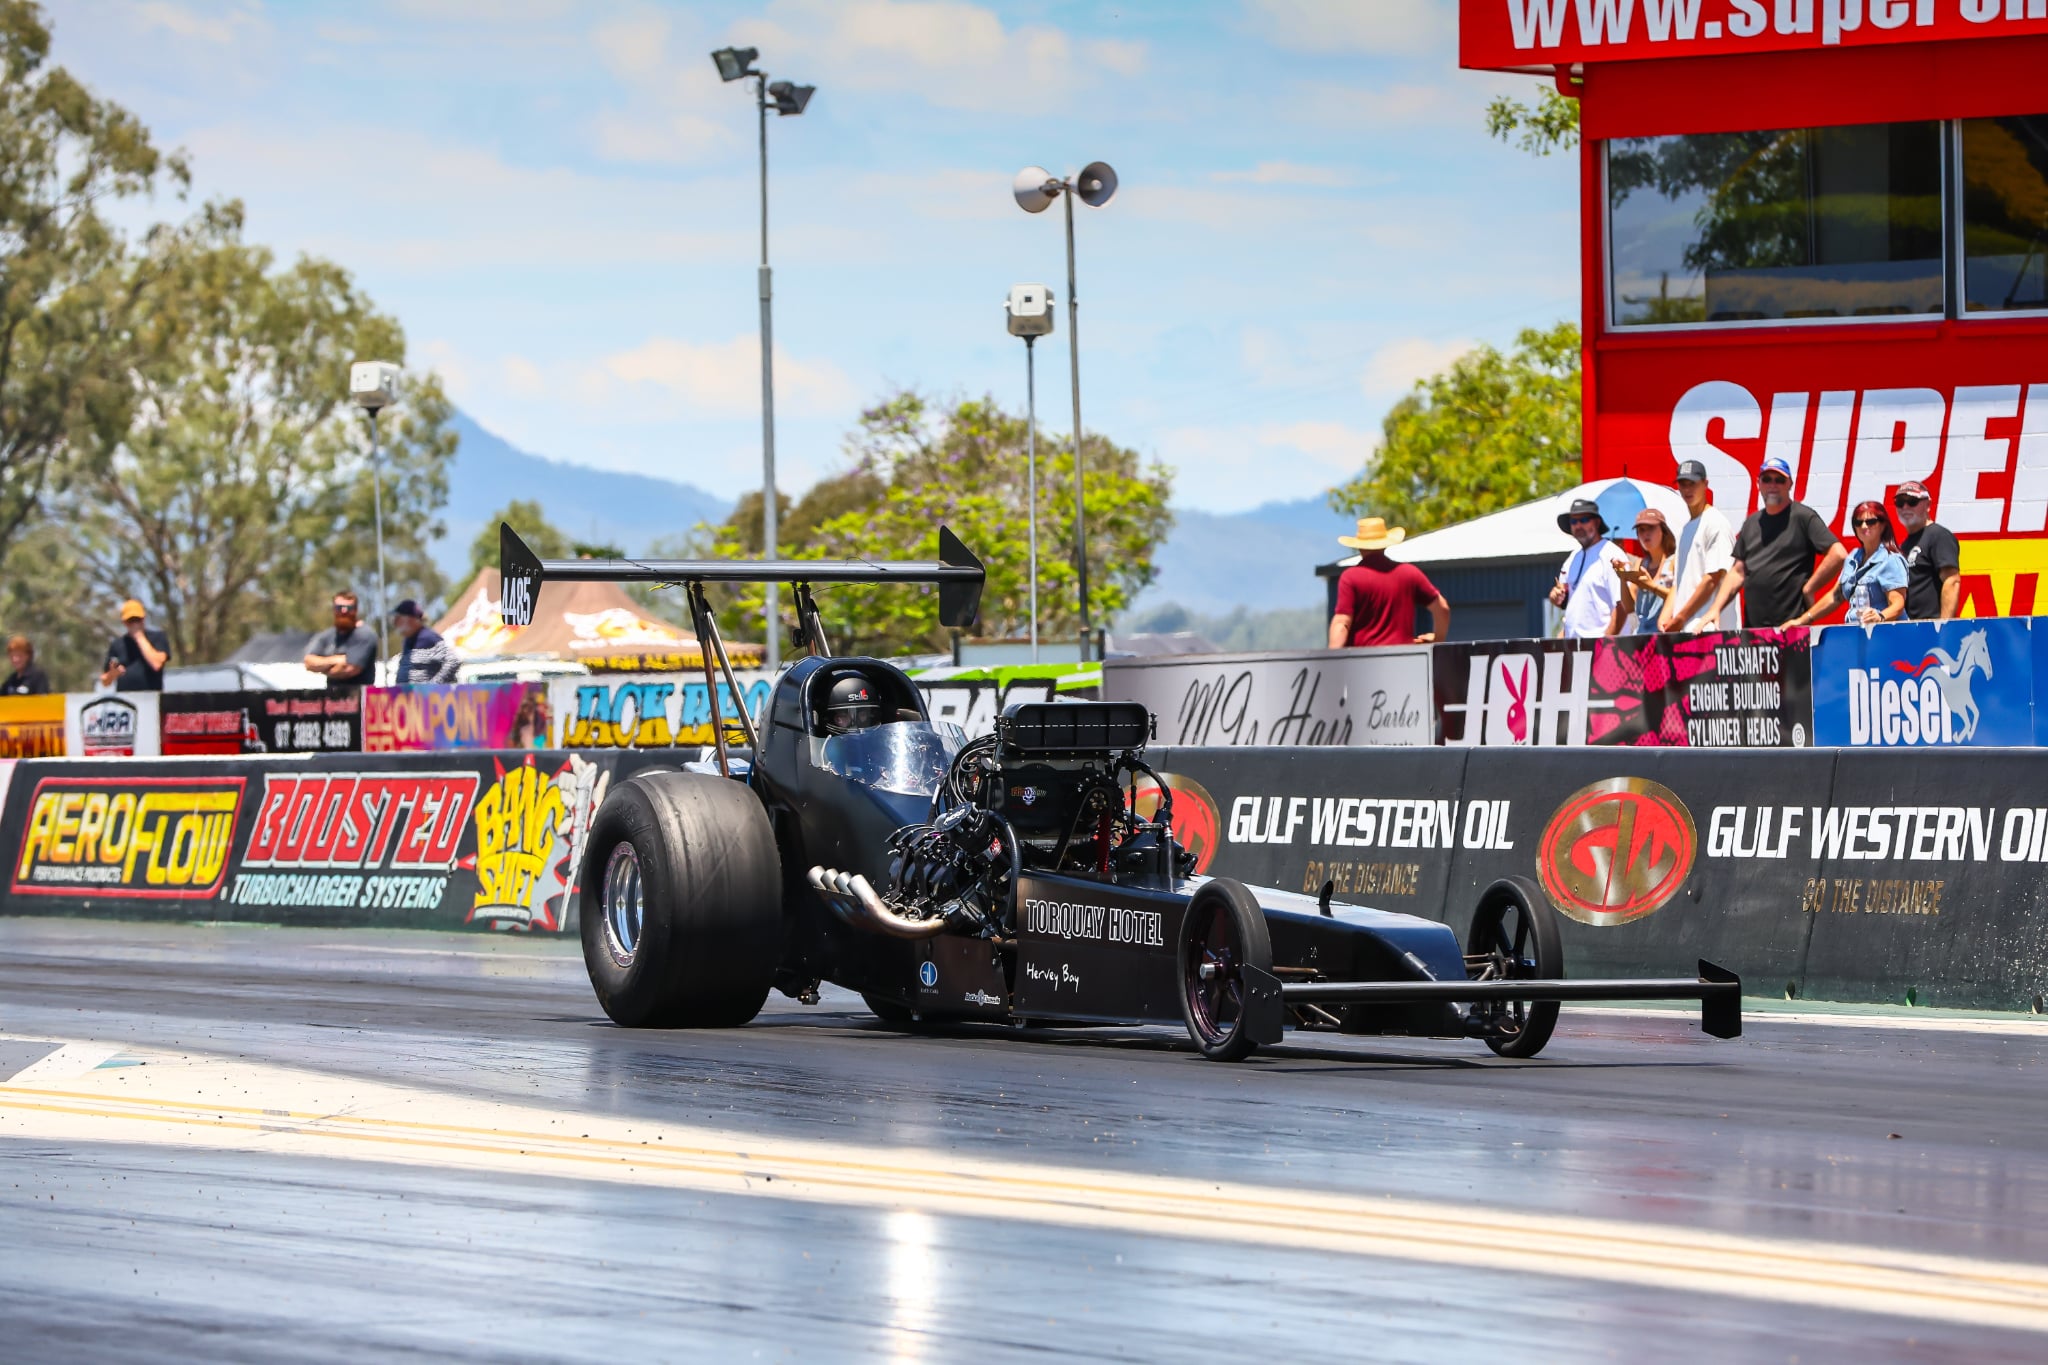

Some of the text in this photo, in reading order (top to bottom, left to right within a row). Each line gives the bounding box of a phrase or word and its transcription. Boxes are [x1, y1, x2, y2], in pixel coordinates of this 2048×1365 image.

[501, 577, 531, 625] 4485
[1715, 646, 1779, 676] TAILSHAFTS
[1367, 689, 1420, 730] Barber
[1689, 681, 1780, 712] ENGINE BUILDING
[1848, 664, 1952, 746] Diesel
[1687, 716, 1780, 747] CYLINDER HEADS
[240, 771, 480, 870] BOOSTED
[475, 765, 565, 858] BANG
[1228, 796, 1514, 850] GULF WESTERN OIL
[1706, 806, 1804, 858] GULF
[1810, 807, 1996, 861] WESTERN
[18, 792, 239, 885] AEROFLOW
[230, 873, 447, 909] TURBOCHARGER SYSTEMS
[474, 851, 546, 909] SHIFT
[1303, 860, 1420, 896] GO THE DISTANCE
[1802, 877, 1945, 916] GO THE DISTANCE
[1026, 898, 1164, 947] TORQUAY HOTEL
[1026, 961, 1080, 993] Hervey Bay
